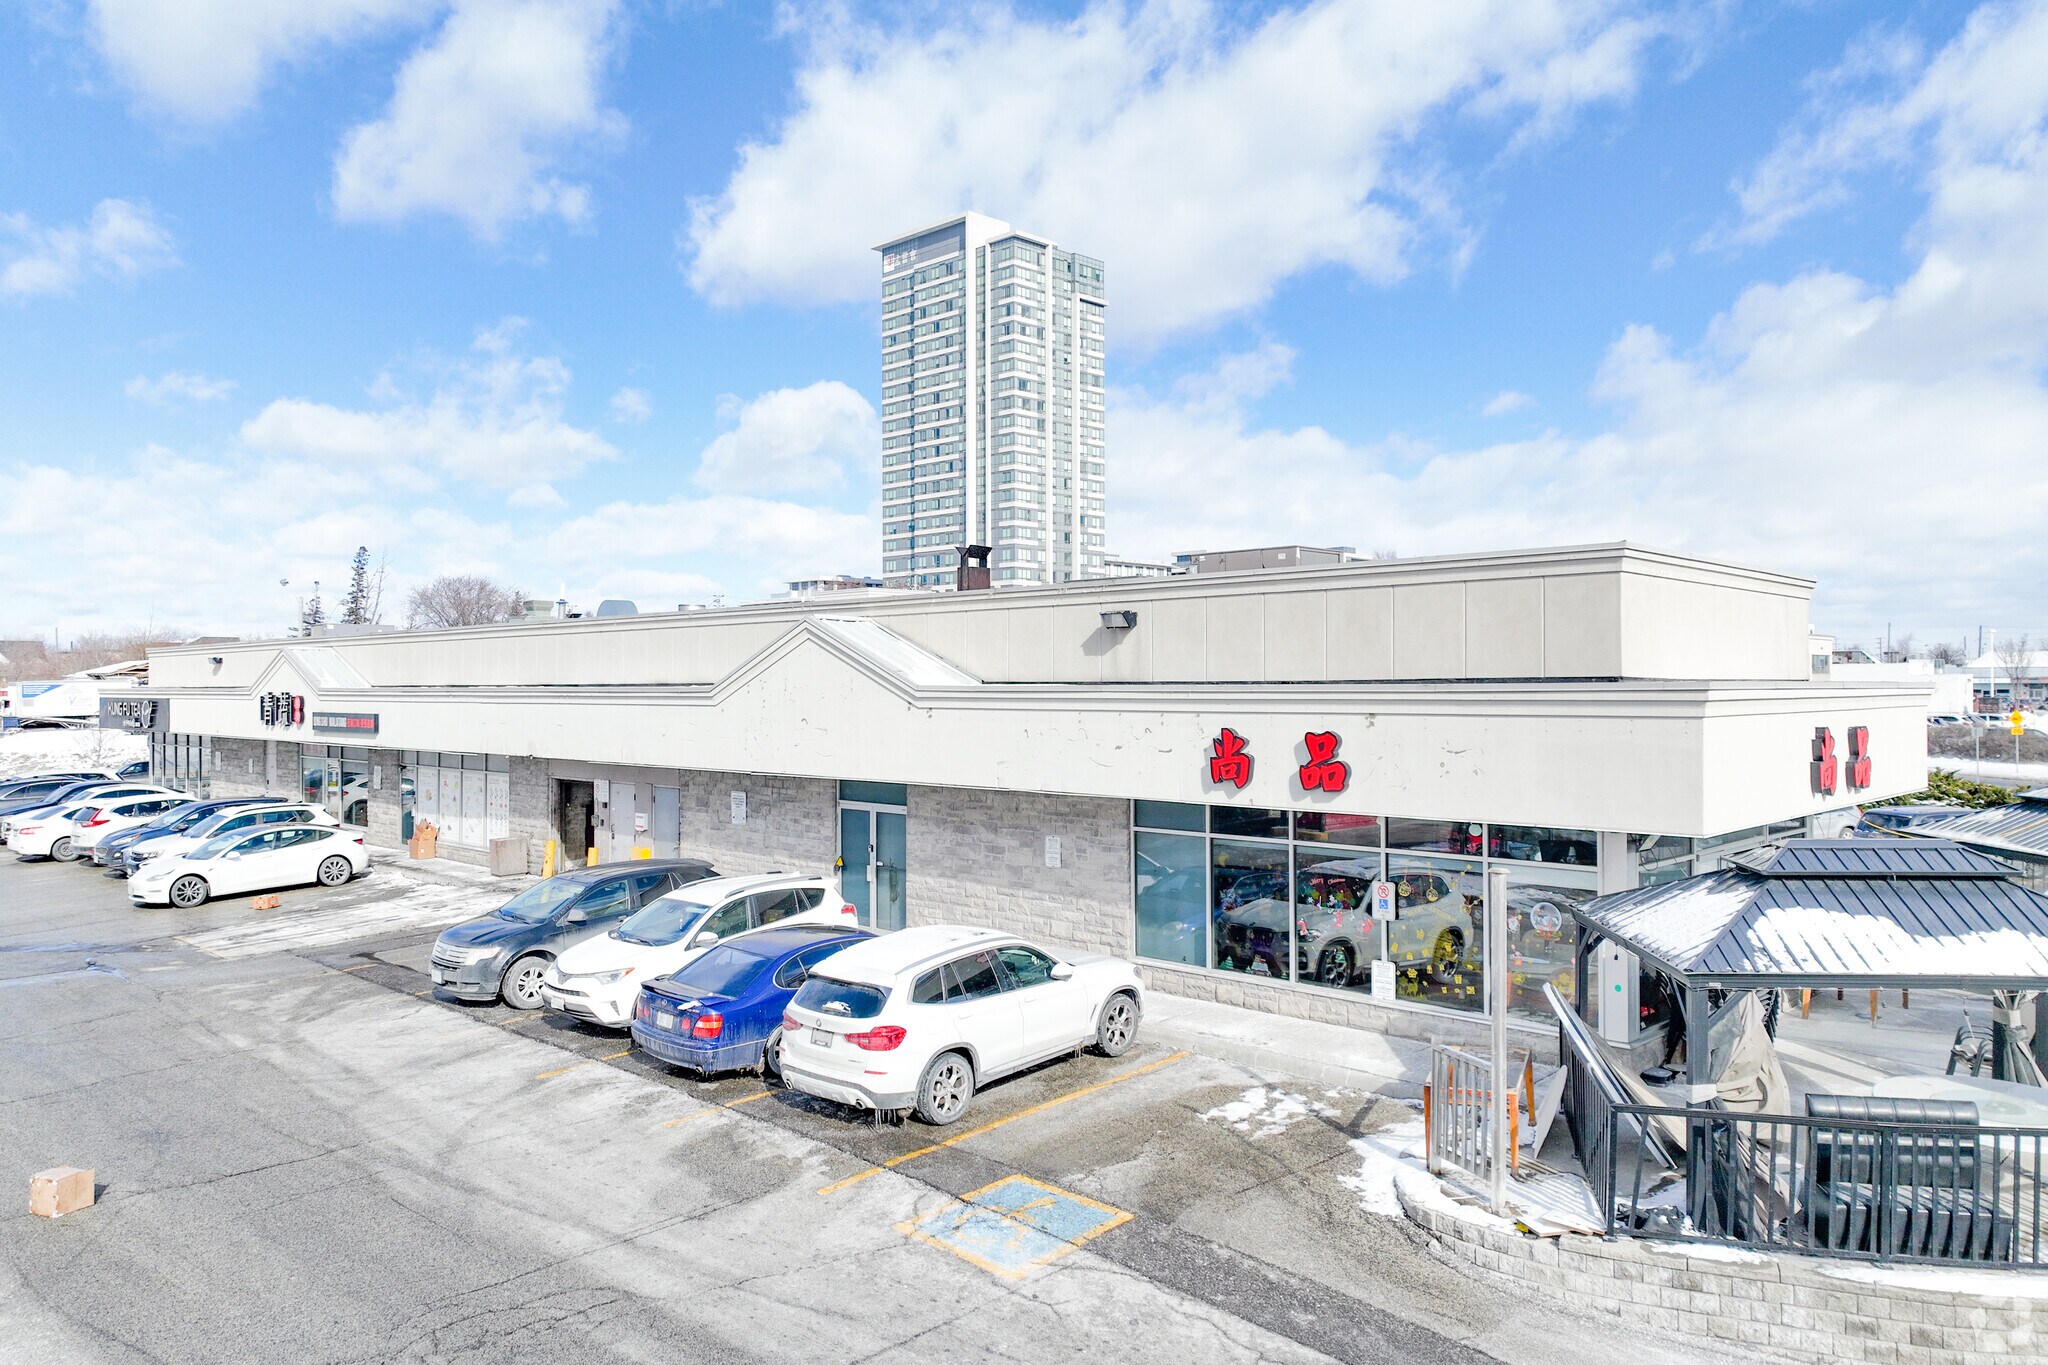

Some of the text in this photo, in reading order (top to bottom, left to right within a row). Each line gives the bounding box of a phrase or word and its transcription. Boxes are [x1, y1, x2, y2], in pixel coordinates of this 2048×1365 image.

[107, 701, 123, 716] KUNG
[122, 702, 131, 717] FU
[130, 702, 141, 717] TEA
[1210, 728, 1347, 792] 尚品
[1815, 726, 1871, 796] 尚品
